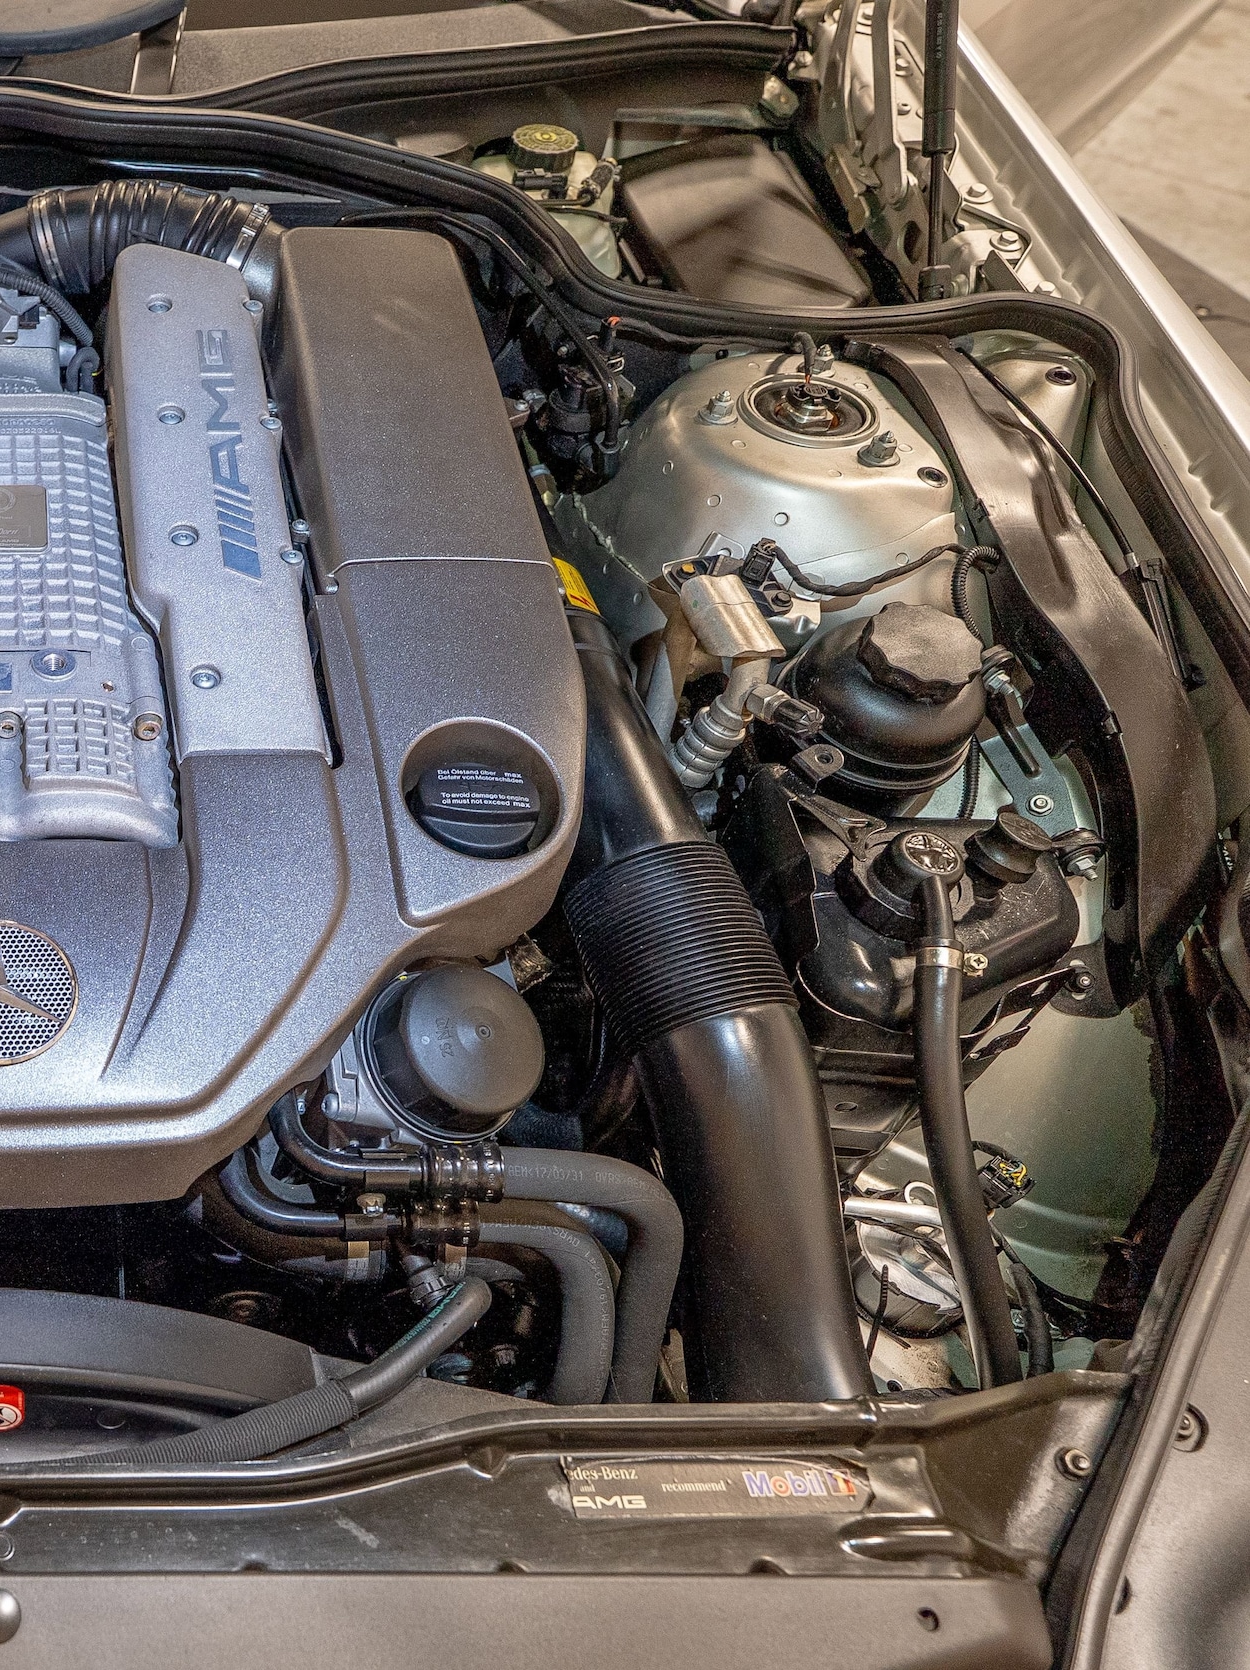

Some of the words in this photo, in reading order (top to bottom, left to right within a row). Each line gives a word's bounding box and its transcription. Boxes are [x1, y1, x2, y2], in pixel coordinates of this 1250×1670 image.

[195, 330, 250, 496] AMG
[579, 1483, 596, 1493] and
[661, 1480, 727, 1493] recommend
[742, 1470, 828, 1498] Mobil
[572, 1495, 647, 1509] AMG
